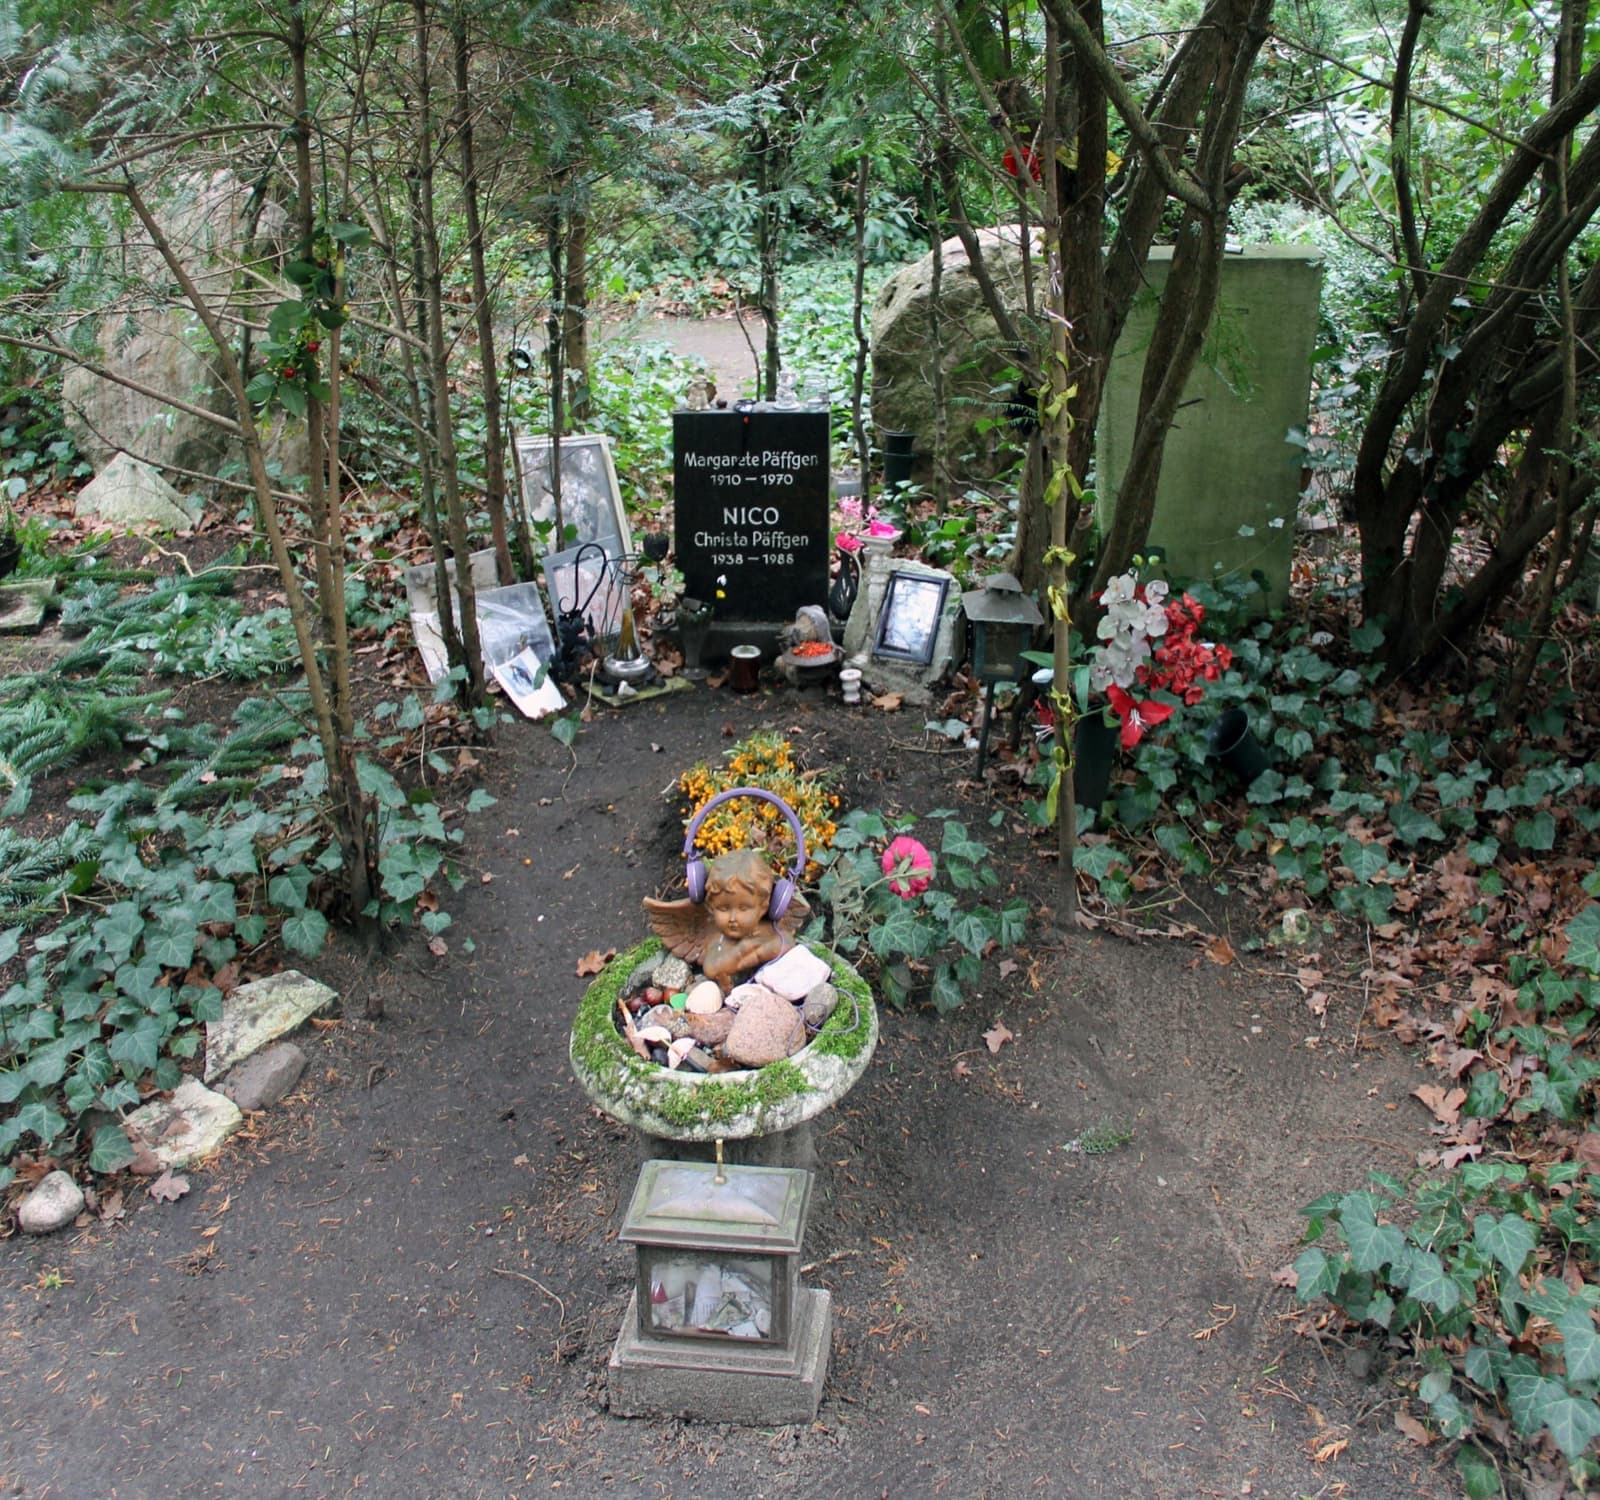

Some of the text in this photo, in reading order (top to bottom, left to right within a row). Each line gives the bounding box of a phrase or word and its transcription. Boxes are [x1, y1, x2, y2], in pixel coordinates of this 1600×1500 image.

[762, 451, 818, 470] Päffgen
[710, 474, 742, 486] 1910
[760, 474, 794, 486] 1970
[723, 507, 780, 525] NICO
[694, 531, 809, 549] Christa Päffgen
[711, 553, 744, 565] 1938
[762, 553, 795, 565] 1988
